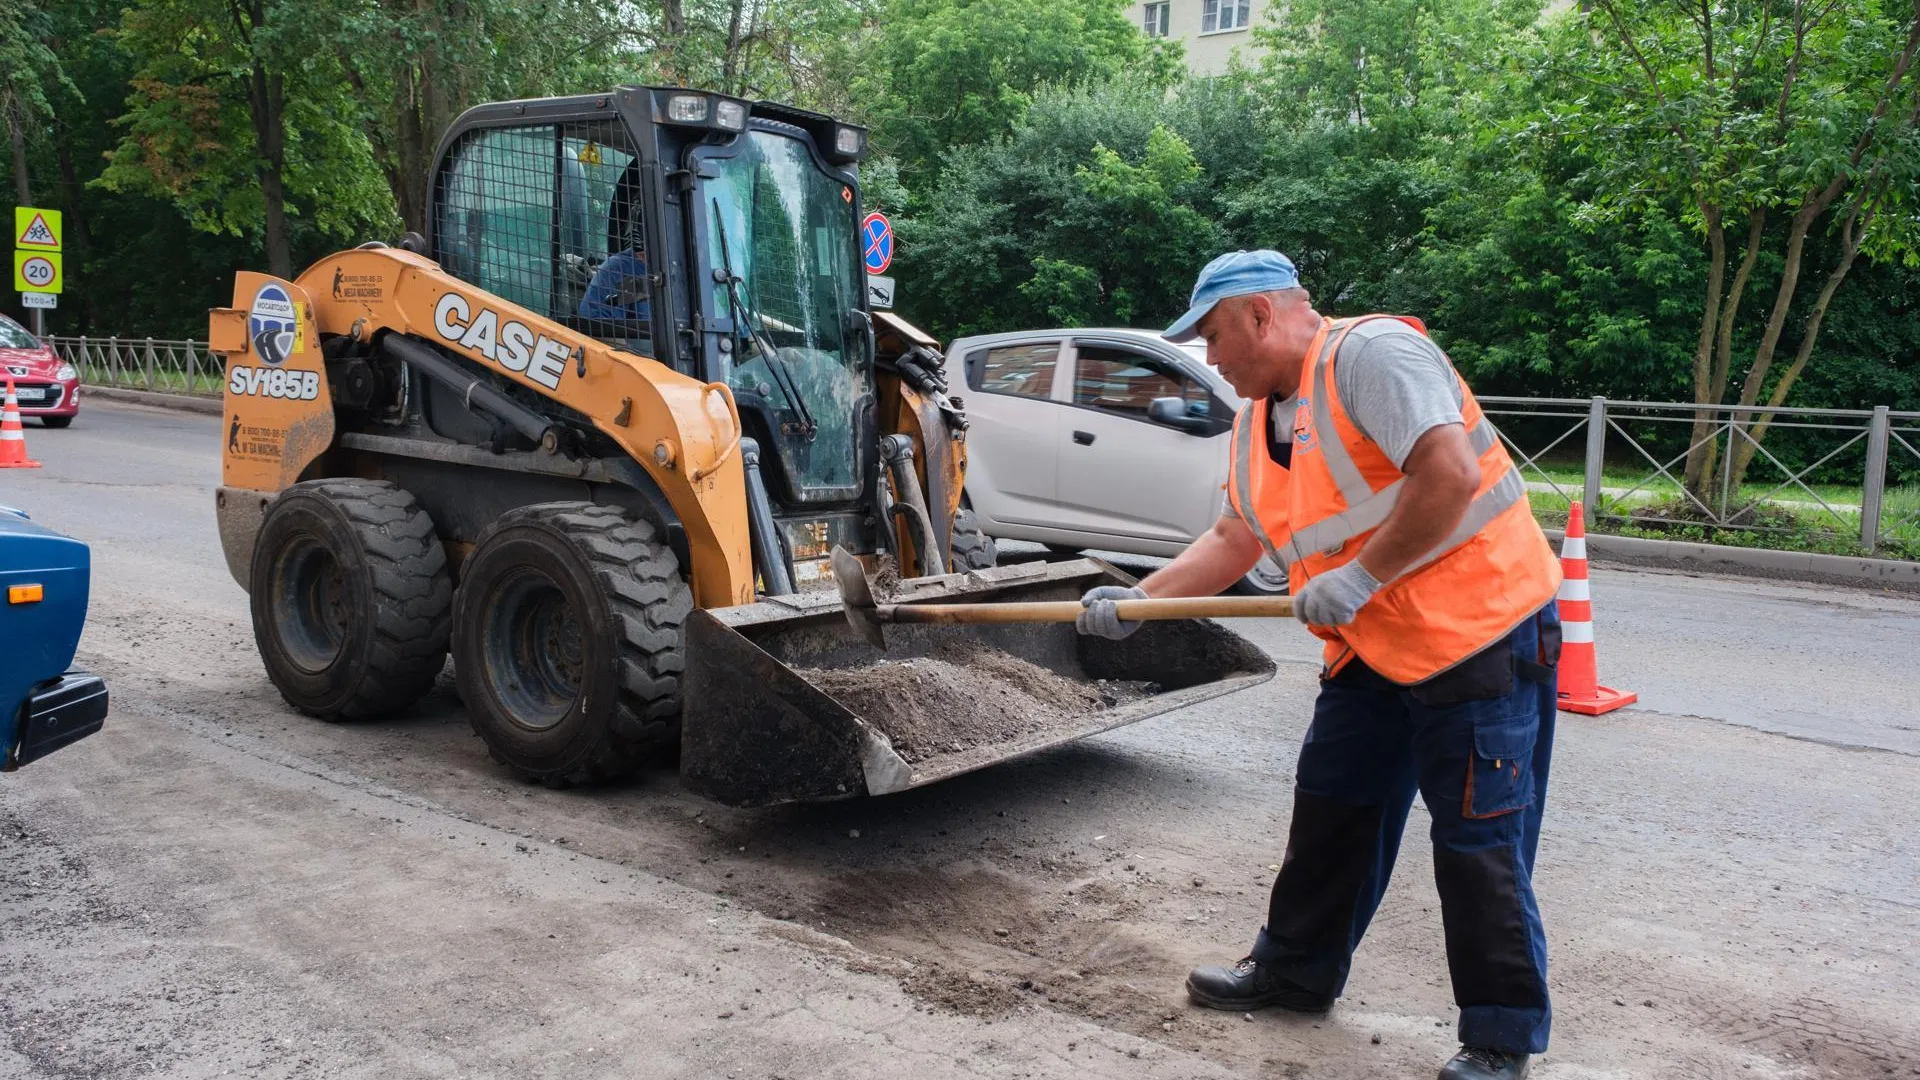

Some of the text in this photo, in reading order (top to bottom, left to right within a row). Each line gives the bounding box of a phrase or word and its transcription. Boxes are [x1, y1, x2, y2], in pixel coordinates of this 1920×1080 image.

[29, 265, 48, 278] 20
[257, 302, 290, 312] МОСАВТОДОР
[434, 292, 571, 391] CASE
[230, 365, 319, 400] SV185B
